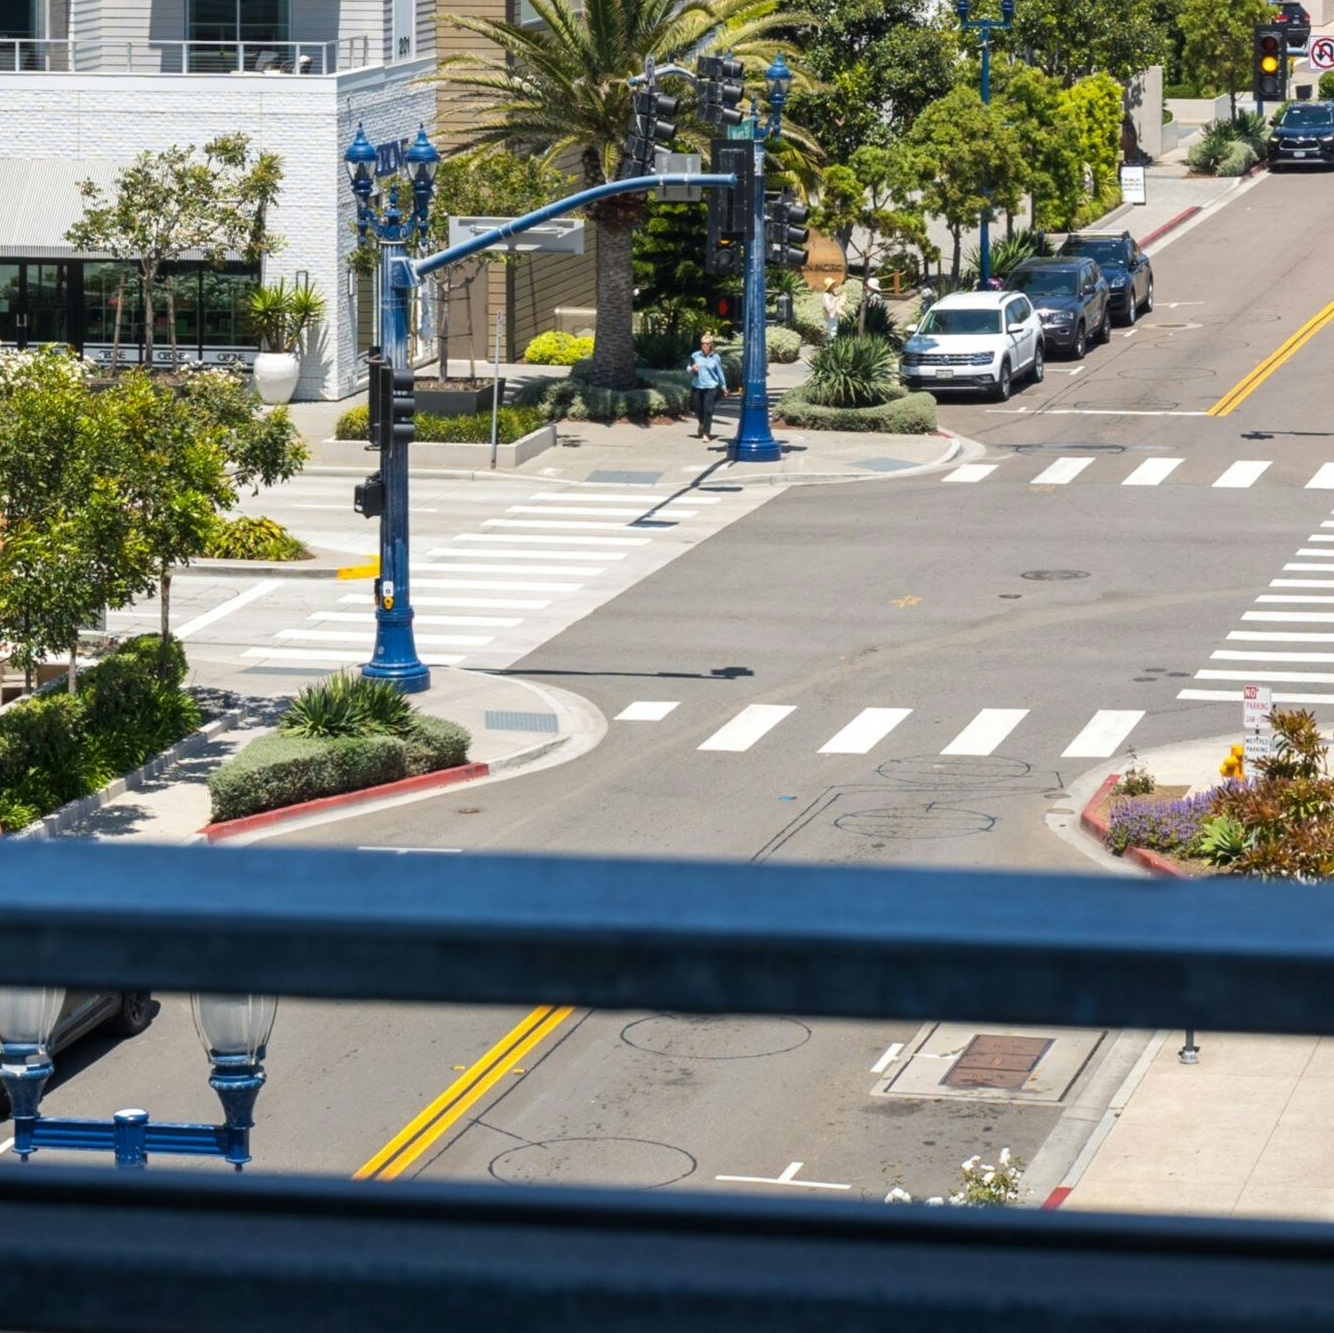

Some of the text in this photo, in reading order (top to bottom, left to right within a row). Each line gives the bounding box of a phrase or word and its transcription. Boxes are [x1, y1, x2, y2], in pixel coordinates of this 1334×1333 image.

[399, 36, 410, 54] 201
[1245, 688, 1257, 699] NO
[1244, 702, 1270, 710] PARKING
